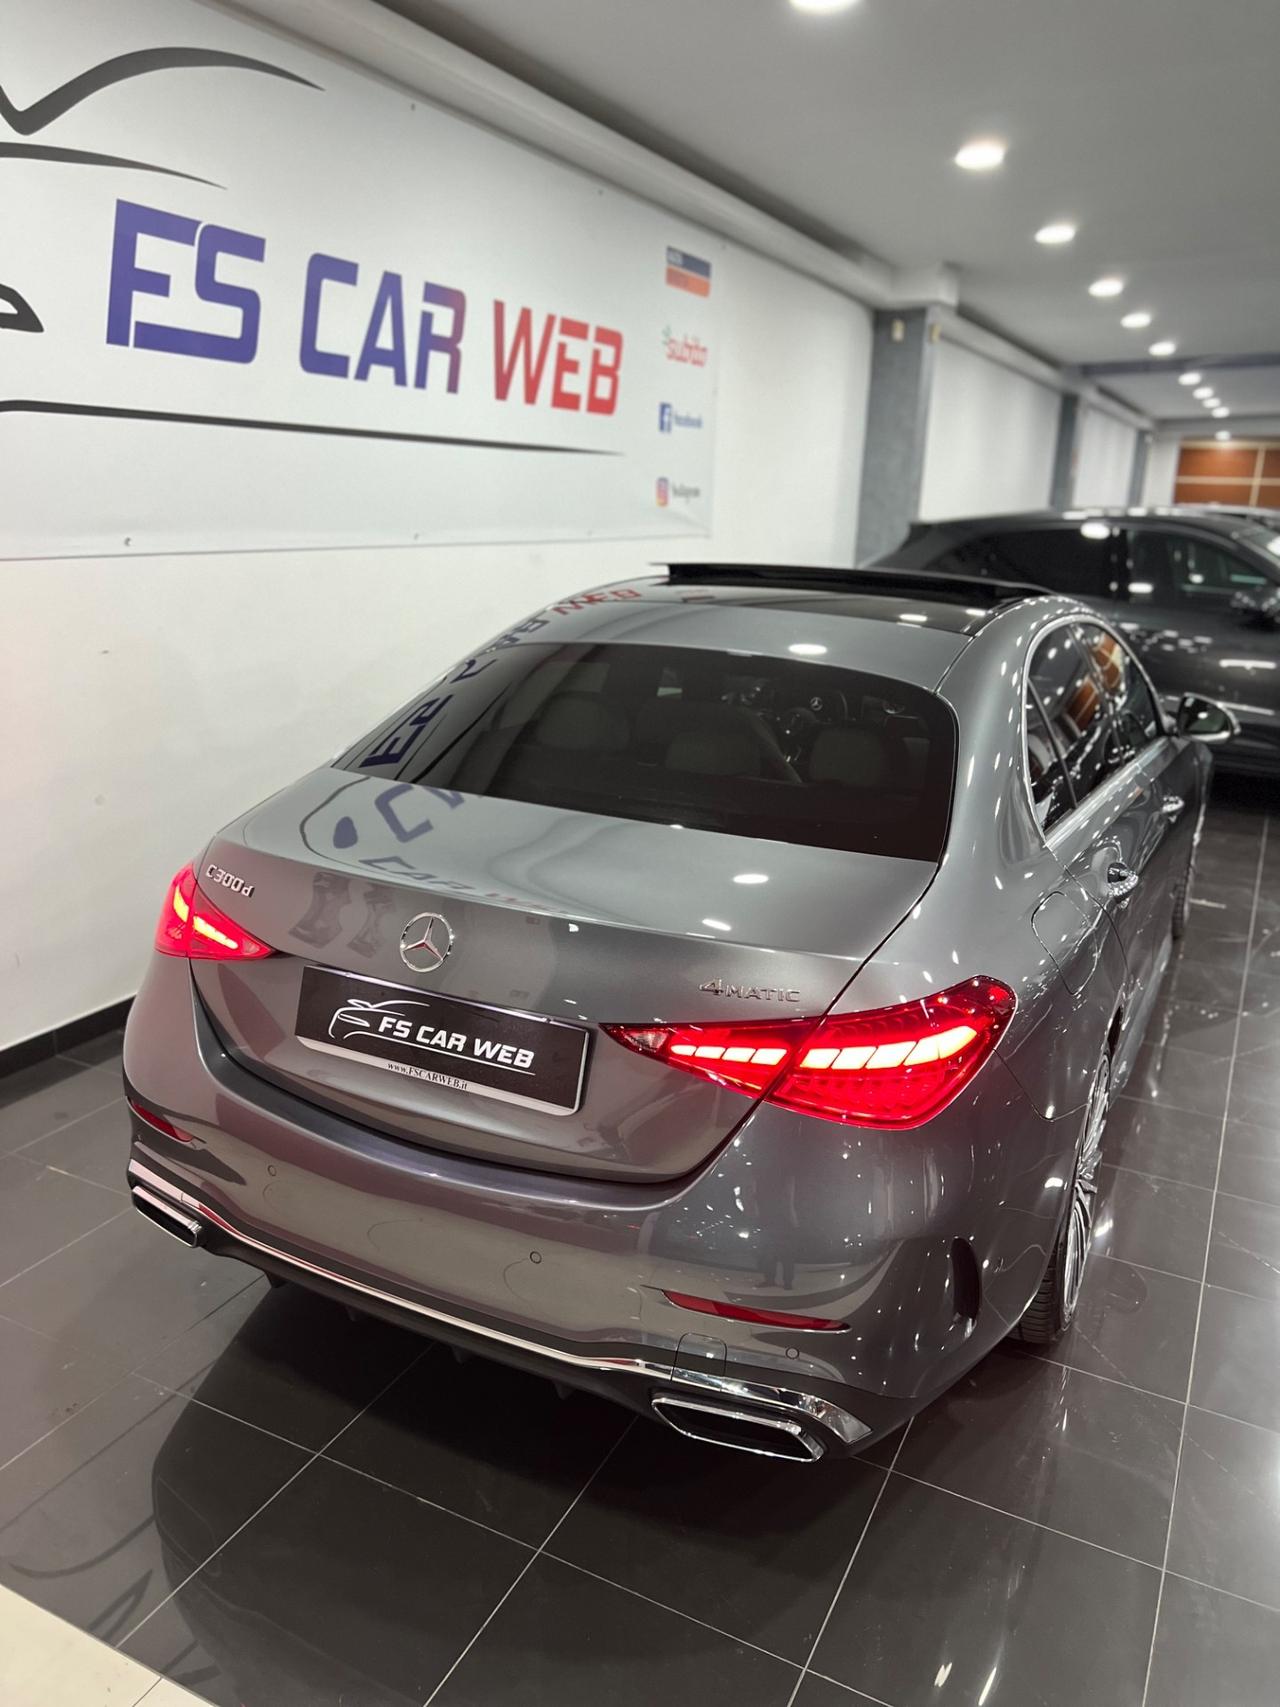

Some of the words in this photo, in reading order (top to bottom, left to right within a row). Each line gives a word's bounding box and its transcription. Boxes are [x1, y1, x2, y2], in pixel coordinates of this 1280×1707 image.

[106, 200, 266, 365] FS
[299, 253, 468, 394] CAR
[494, 299, 624, 416] WEB
[206, 864, 255, 898] C300d
[699, 979, 800, 1003] 4MATIC
[378, 1016, 413, 1039] FS
[416, 1025, 467, 1052] CAR
[473, 1038, 535, 1069] WEB
[387, 1062, 469, 1090] www.FSCARWEB.it
